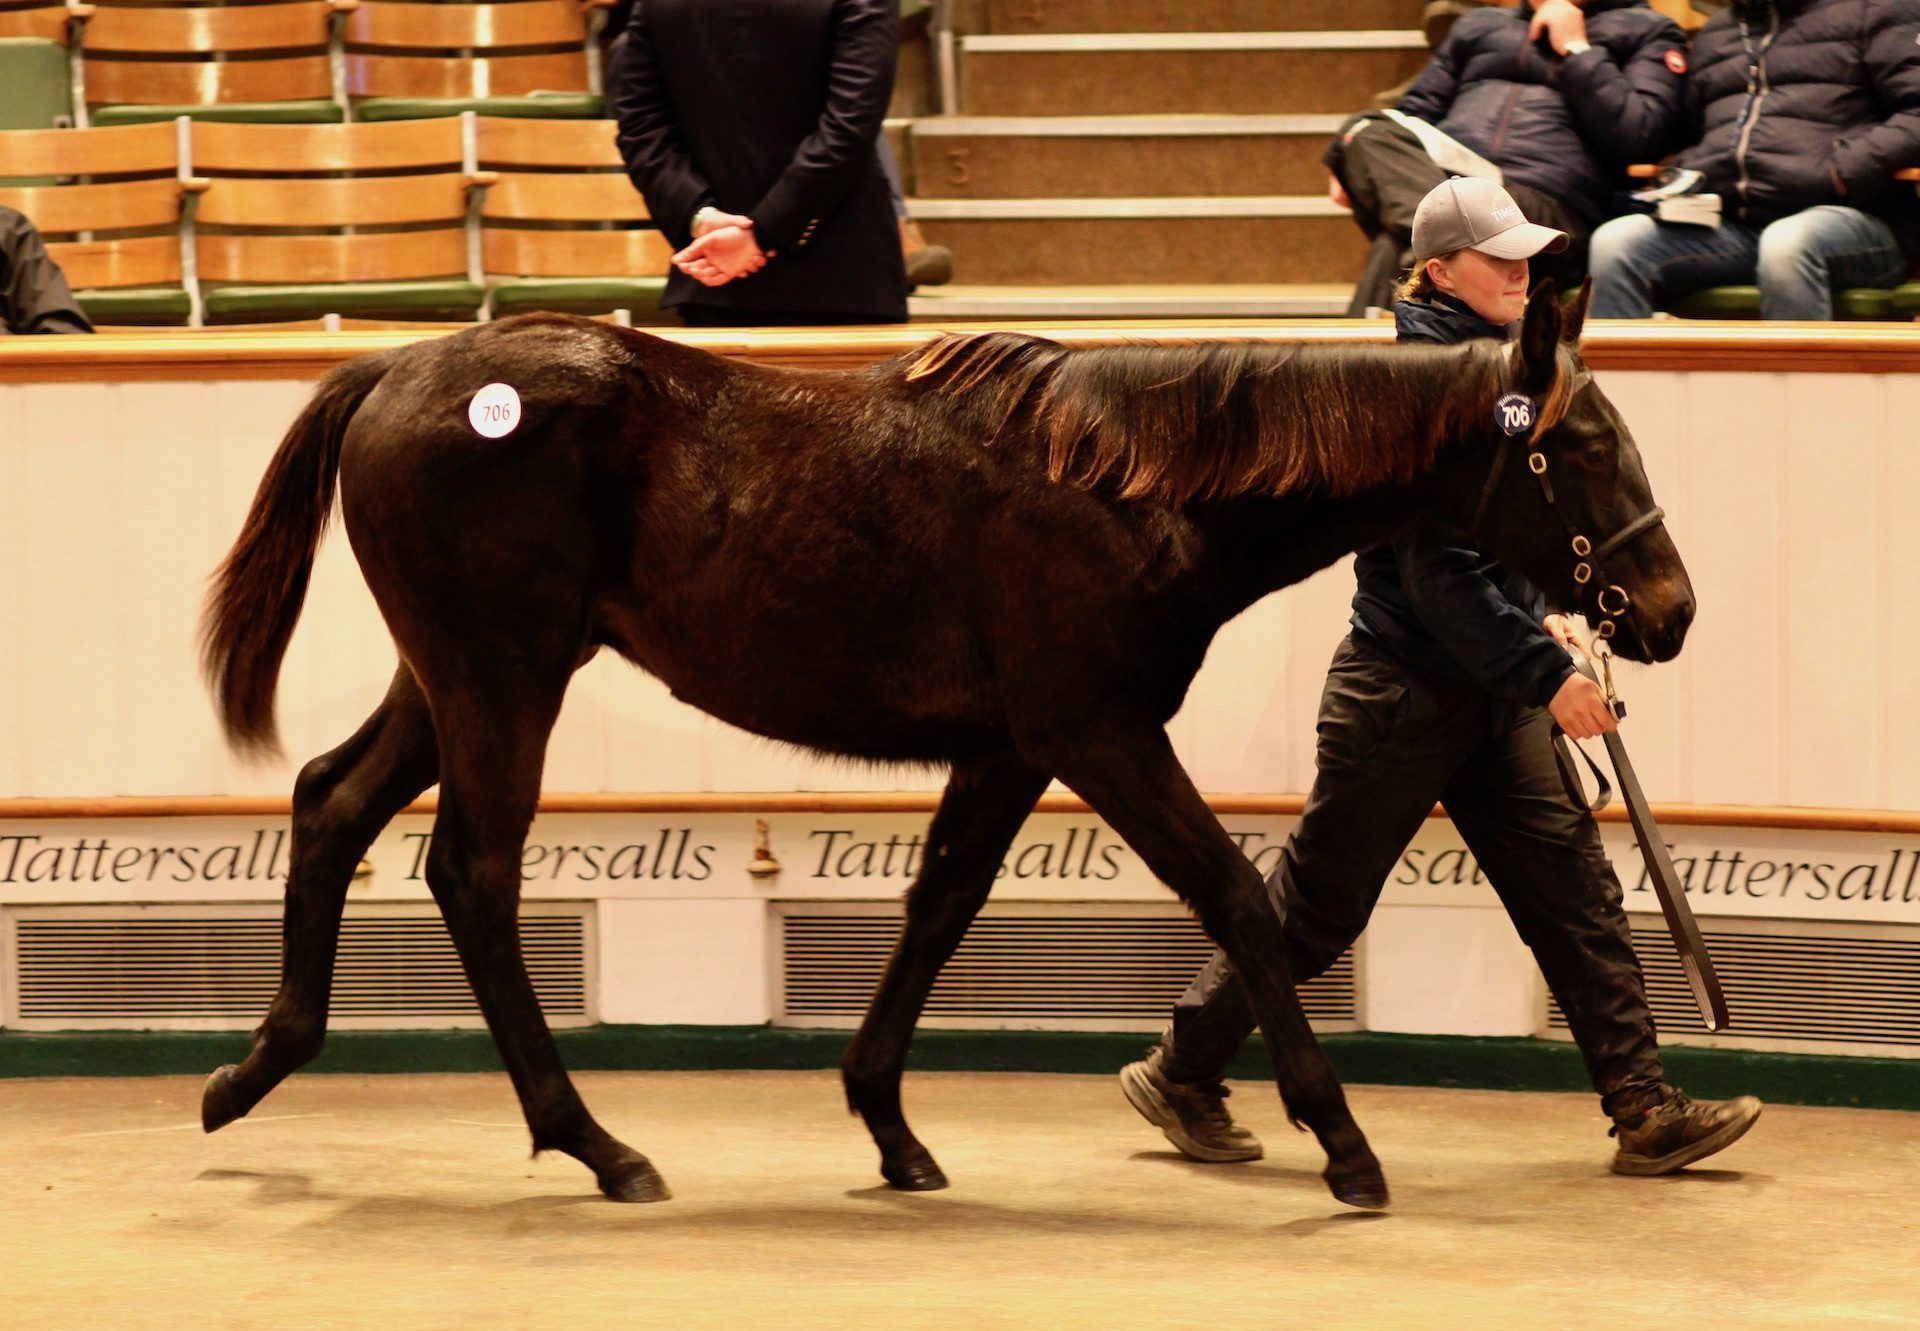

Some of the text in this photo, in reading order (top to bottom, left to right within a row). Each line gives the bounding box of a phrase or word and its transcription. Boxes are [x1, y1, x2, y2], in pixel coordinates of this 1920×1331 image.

[483, 403, 510, 422] 706
[1502, 404, 1530, 428] 706
[0, 829, 290, 883] Tattersall
[402, 828, 716, 881] Tersalls
[810, 827, 1125, 880] Tattalls
[1629, 843, 1920, 903] Tattersall
